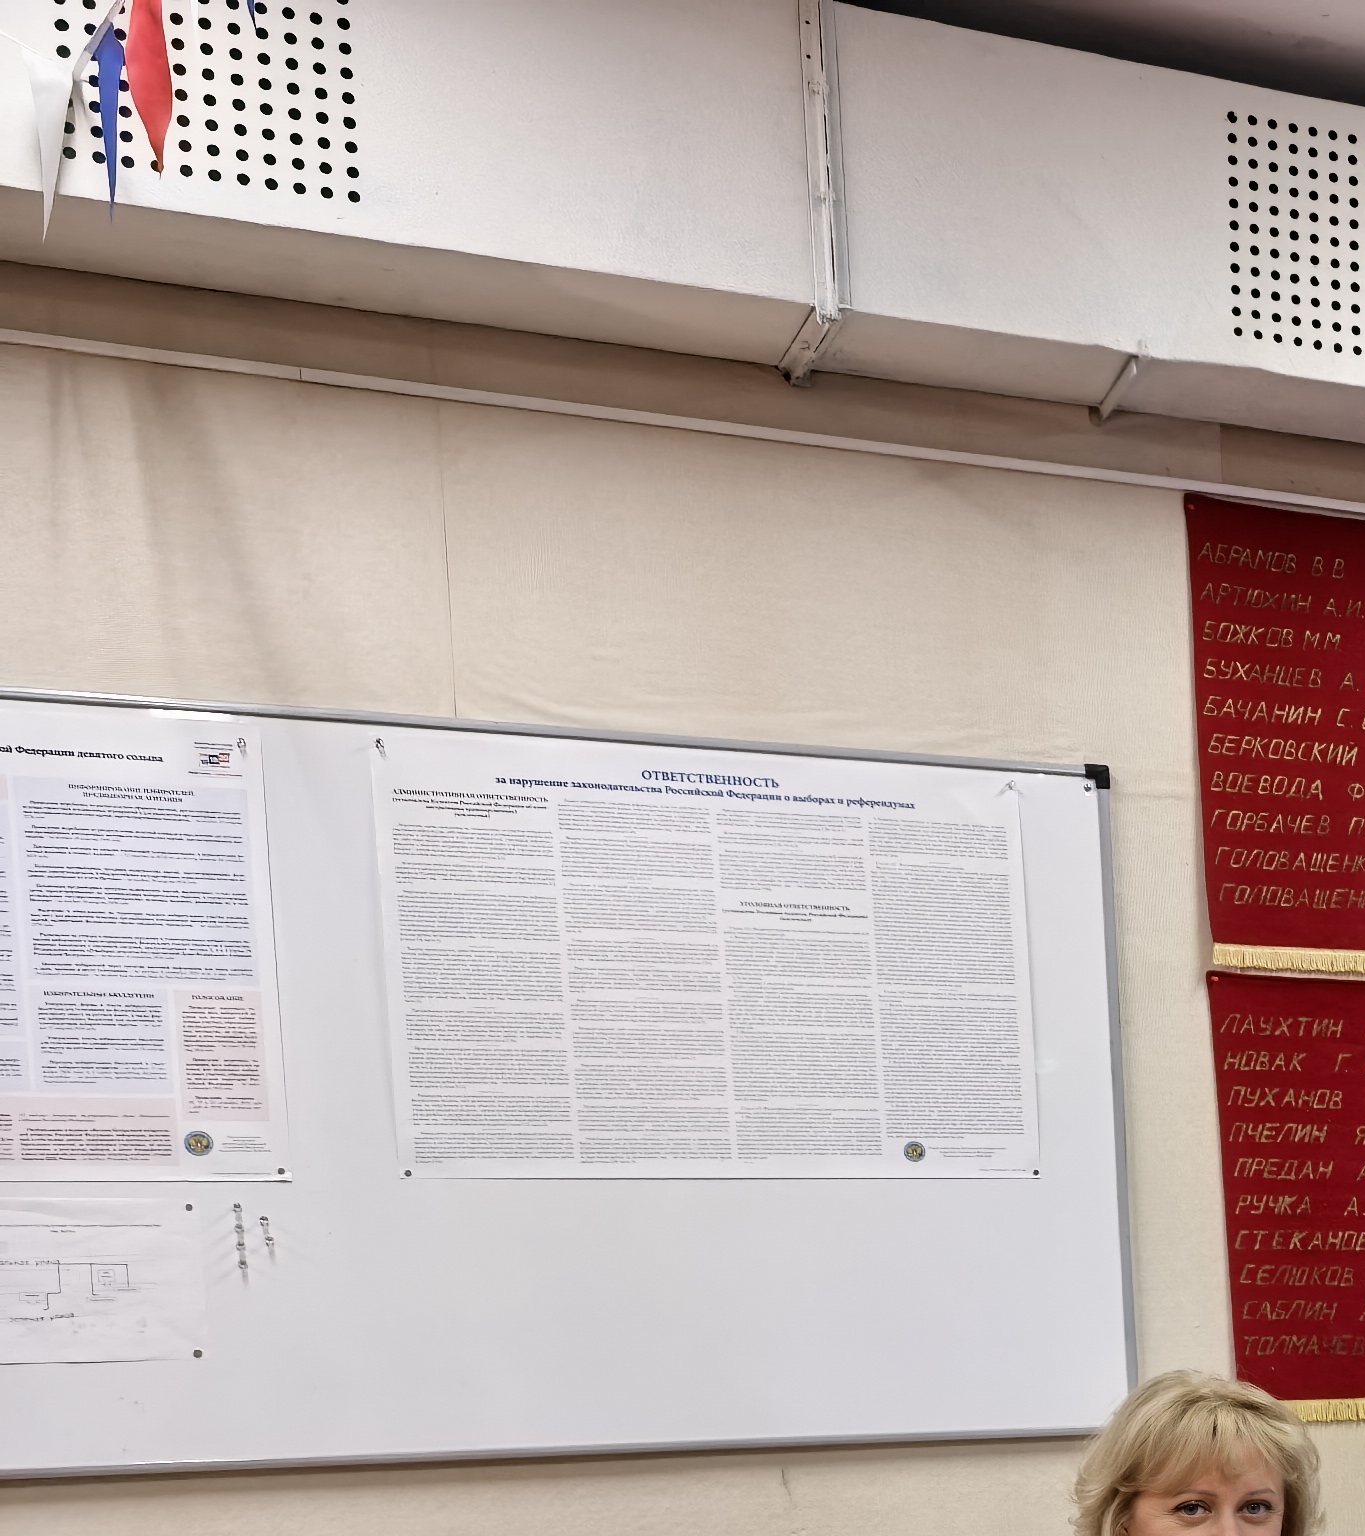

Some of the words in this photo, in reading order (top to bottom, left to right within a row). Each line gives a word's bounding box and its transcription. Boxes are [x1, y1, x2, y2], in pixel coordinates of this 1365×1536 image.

[1198, 542, 1297, 574] АБРАМОВ
[1200, 582, 1312, 614] АРТЮХИН
[1202, 620, 1294, 648] БОЖКОВ
[1203, 657, 1323, 689] БУХАНЦЕВ
[1202, 695, 1322, 726] БАЧАНИН
[14, 745, 75, 758] Федерации
[77, 750, 125, 761] девятого
[1207, 733, 1359, 767] БЕРКОВСКИЙ
[641, 769, 780, 789] ОТВЕТСТВЕННОСТЬ
[1210, 770, 1324, 801] ВОЕВОДА
[494, 776, 507, 786] за
[509, 777, 570, 790] нарушение
[571, 781, 663, 796] законодательства
[664, 784, 725, 800] Российской
[726, 789, 783, 803] Федерации
[792, 792, 836, 805] выборах
[846, 796, 917, 811] референдумах
[1210, 809, 1331, 835] ГОРБАЧЕВ
[1223, 1050, 1308, 1072] НОВАК
[1227, 1085, 1343, 1110] ПУХАНОВ
[1228, 1121, 1329, 1145] ПЧЕЛИН
[1233, 1157, 1334, 1181] ПРЕДАН
[1235, 1193, 1312, 1217] РУЧКА
[1239, 1263, 1356, 1288] СЕЛЮКОВ
[1242, 1299, 1339, 1322] САБЛИН
